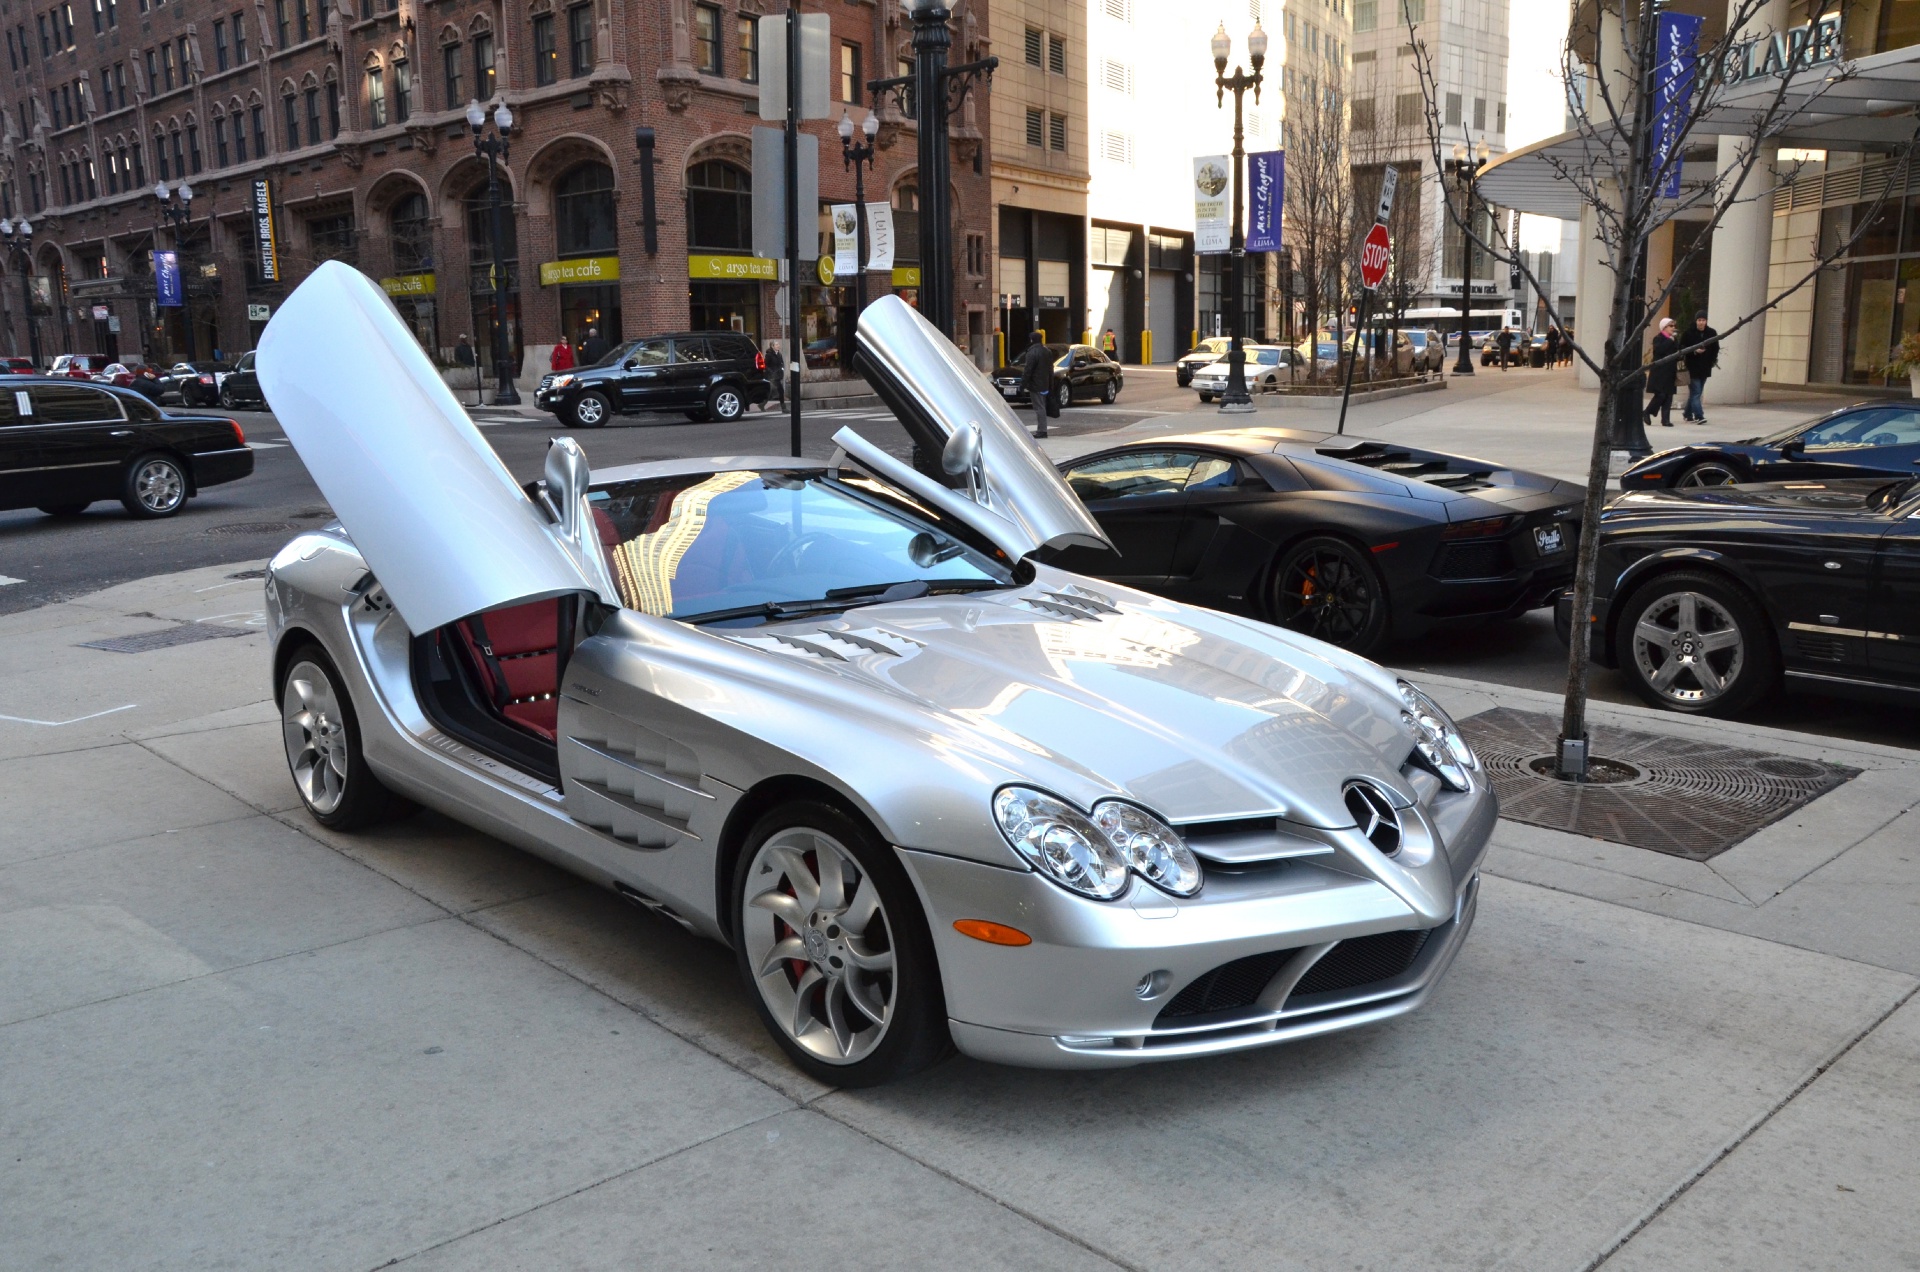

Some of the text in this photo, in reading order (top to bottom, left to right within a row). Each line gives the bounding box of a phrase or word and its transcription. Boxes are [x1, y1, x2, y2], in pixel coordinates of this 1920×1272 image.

[1257, 157, 1274, 202] Chagall
[1385, 170, 1397, 186] ONE
[1382, 184, 1394, 199] WAY
[256, 181, 275, 280] EINSTEIN BROS. BAGELS
[1257, 204, 1265, 233] Marc
[874, 211, 887, 258] LUMA
[1363, 242, 1389, 270] STOP
[547, 259, 601, 282] argo tea café
[726, 263, 748, 277] argo
[749, 263, 761, 274] tea
[1484, 284, 1497, 293] rack
